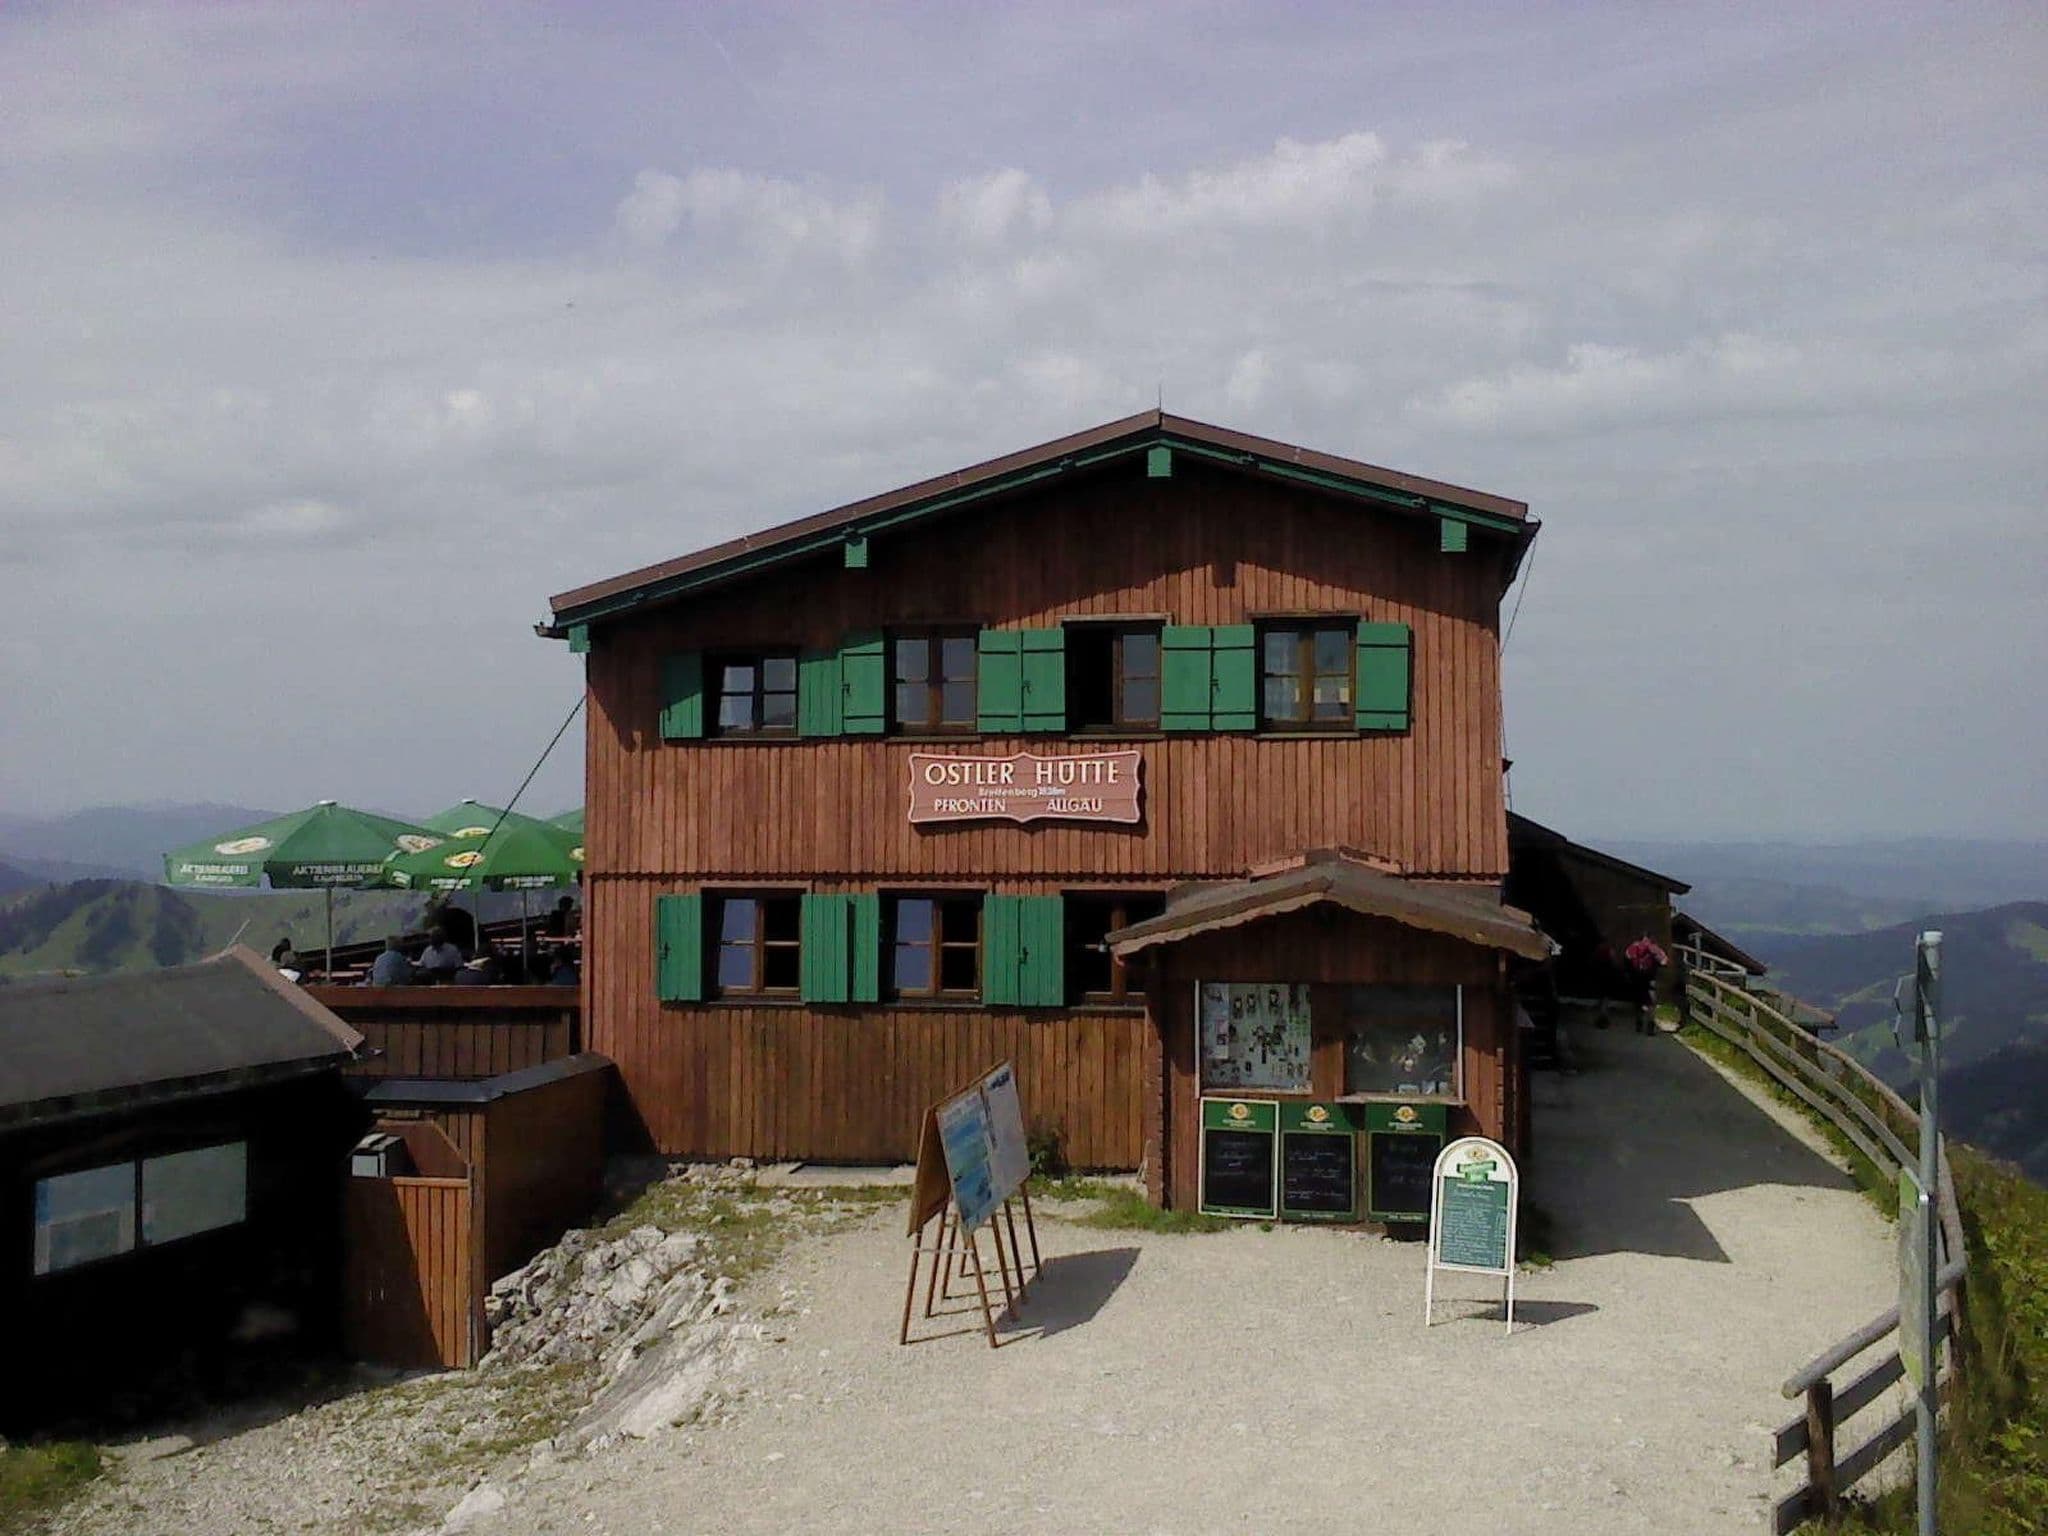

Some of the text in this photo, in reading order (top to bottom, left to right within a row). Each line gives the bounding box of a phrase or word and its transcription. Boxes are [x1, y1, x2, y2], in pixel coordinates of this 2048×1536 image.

[924, 760, 1120, 785] OSTLER HÜTTE
[934, 798, 1007, 813] PFRONTEN
